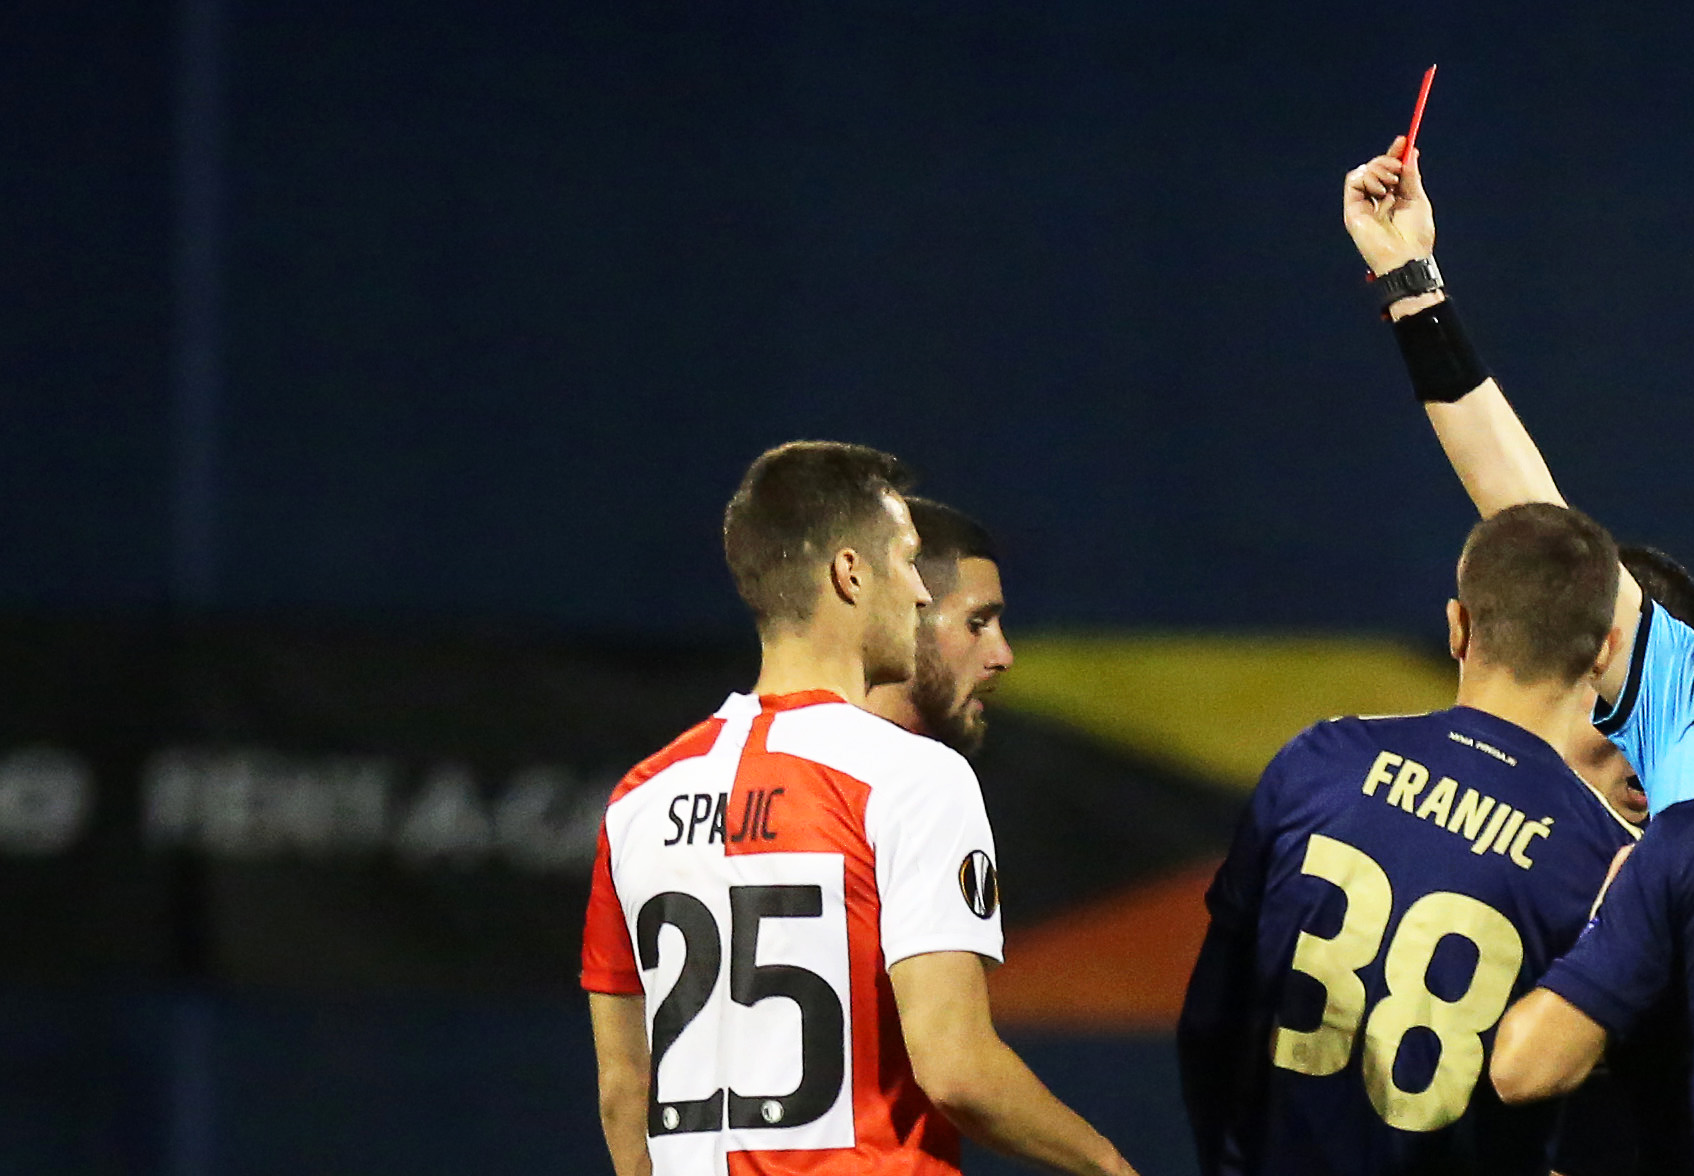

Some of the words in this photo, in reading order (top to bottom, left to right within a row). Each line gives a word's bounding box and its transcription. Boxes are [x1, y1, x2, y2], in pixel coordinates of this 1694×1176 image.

[663, 787, 785, 847] SPAJIC
[1361, 750, 1555, 870] FRANJIĆ
[636, 885, 846, 1138] 25
[1273, 833, 1524, 1132] 38
